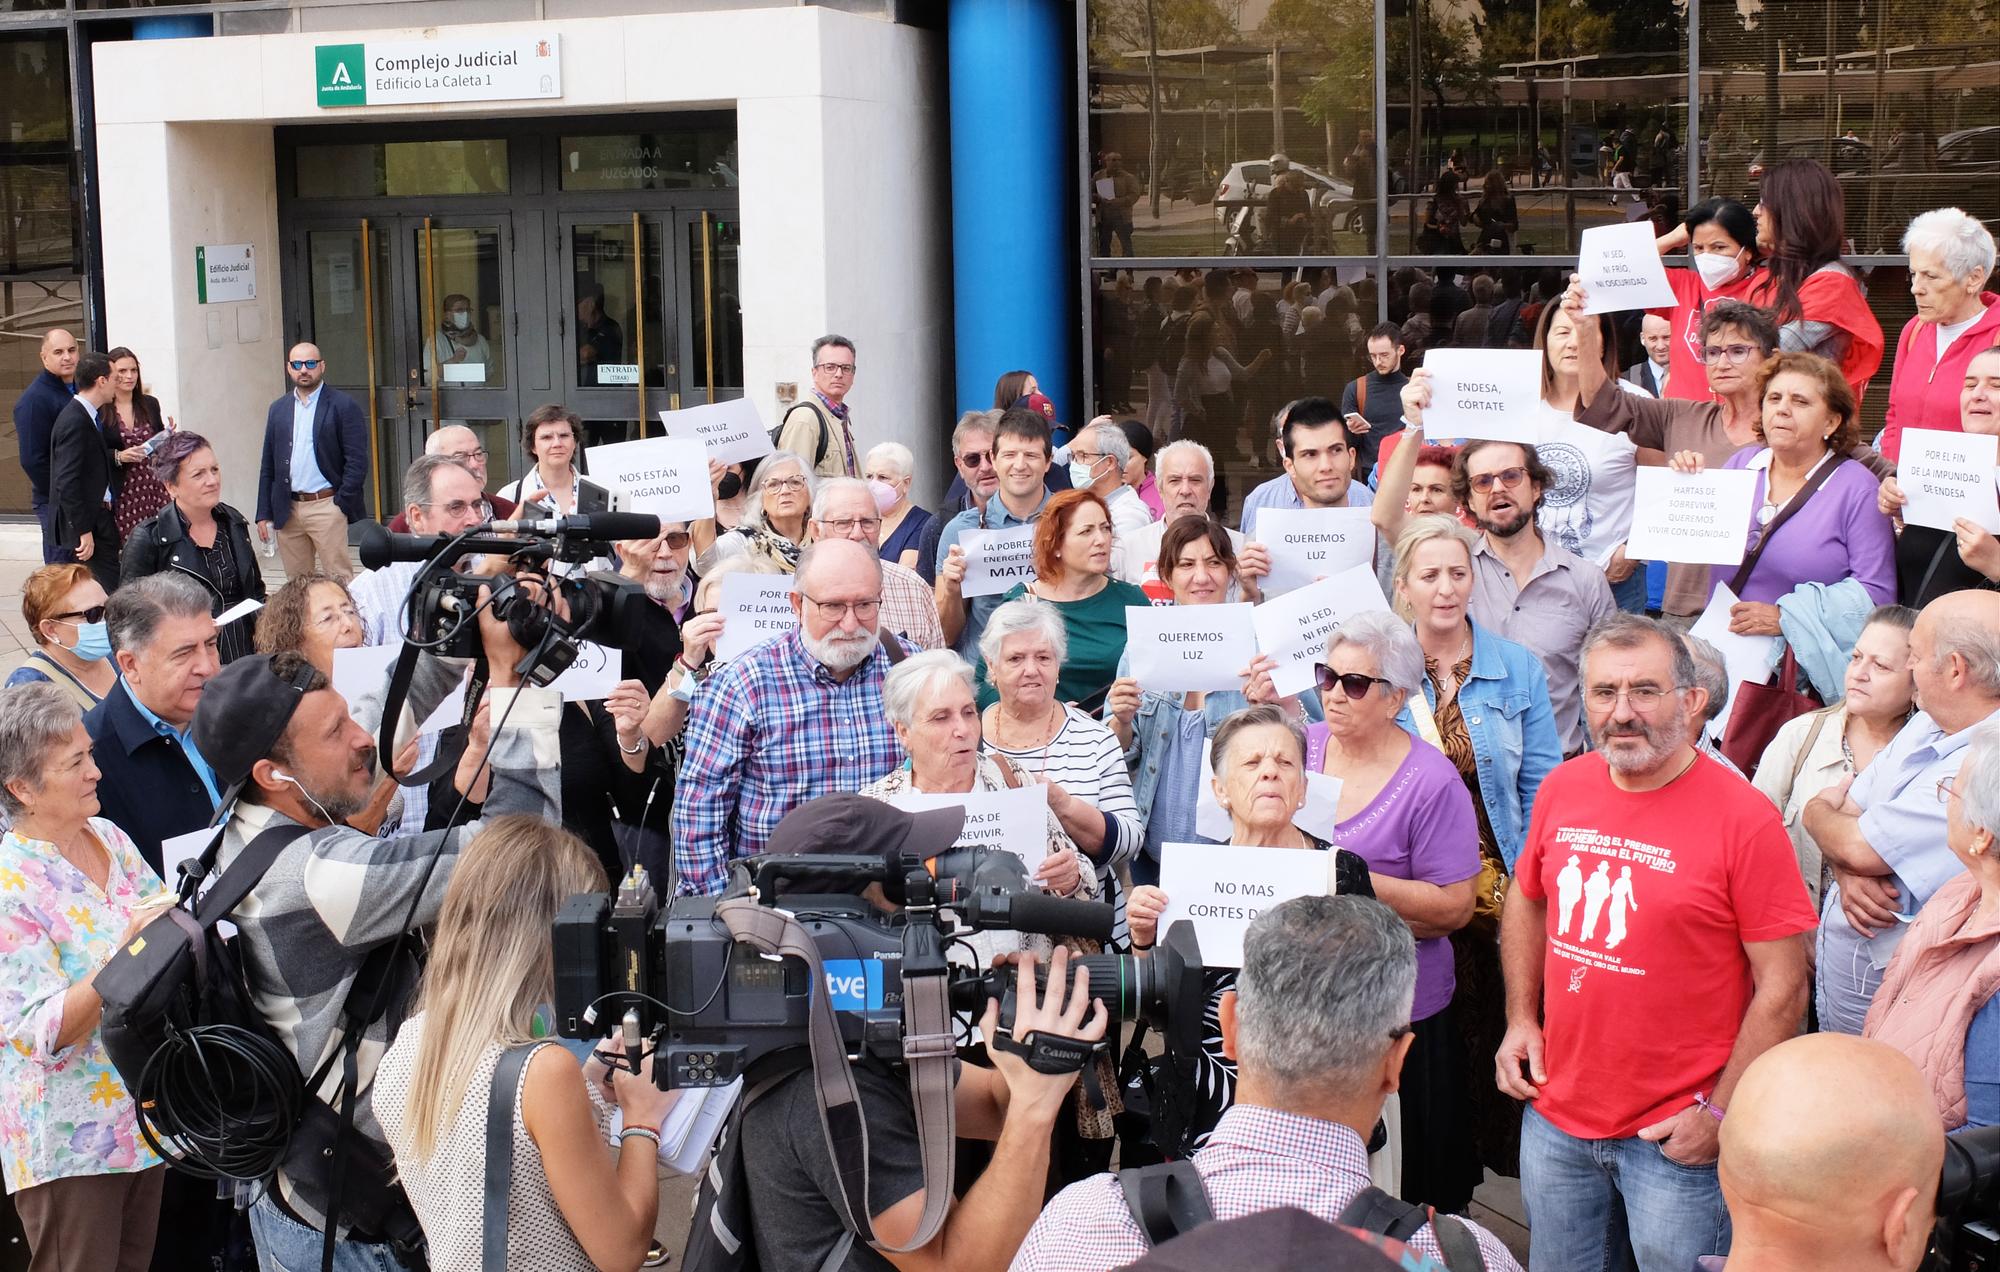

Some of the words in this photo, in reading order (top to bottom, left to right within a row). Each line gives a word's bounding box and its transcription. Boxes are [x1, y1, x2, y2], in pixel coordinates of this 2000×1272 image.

[375, 54, 450, 73] Complejo
[454, 50, 518, 68] Judicial
[376, 76, 422, 91] Edificio
[425, 76, 439, 88] La
[442, 75, 482, 87] Caleta
[485, 75, 492, 85] 1
[653, 146, 662, 159] A
[600, 166, 658, 179] JUZGADOS
[1611, 250, 1626, 259] SED,
[210, 264, 229, 273] Edificio
[230, 263, 250, 272] Judicial
[1605, 277, 1647, 287] OSCURIDAD
[1457, 382, 1501, 395] ENDESA,
[1457, 398, 1505, 412] CÓRTATE
[696, 425, 711, 435] SIN
[713, 423, 728, 432] LUZ
[721, 431, 749, 445] SALUD
[1925, 450, 1941, 461] POR
[1942, 452, 1950, 462] EL
[1953, 453, 1966, 463] FIN
[619, 472, 642, 484] NOS
[644, 467, 678, 481] ESTÁN
[1911, 466, 1921, 476] DE
[1922, 468, 1931, 477] LA
[1932, 469, 1981, 484] IMPUNIDAD
[1673, 486, 1704, 496] HARTAS
[1705, 487, 1717, 496] DE
[1923, 484, 1933, 494] DE
[1934, 486, 1966, 498] ENDESA
[1669, 500, 1718, 511] SOBREVIVIR,
[1668, 513, 1715, 524] QUEREMOS
[1284, 533, 1346, 543] QUEREMOS
[1648, 526, 1669, 535] VIVIR
[1671, 528, 1688, 536] CON
[1690, 529, 1730, 539] DIGNIDAD
[983, 543, 995, 552] LA
[997, 540, 1032, 551] POBREZ
[1307, 551, 1326, 560] LUZ
[990, 564, 1036, 578] MATA
[759, 590, 781, 599] POR
[739, 604, 753, 613] DE
[755, 605, 767, 613] LA
[1298, 615, 1311, 627] NI
[1312, 607, 1336, 622] SED,
[754, 619, 767, 629] DE
[1158, 632, 1224, 643] QUEREMOS
[1302, 631, 1315, 642] NI
[1183, 651, 1204, 660] LUZ
[1292, 649, 1306, 661] NI
[987, 812, 1001, 822] DE
[1555, 832, 1612, 847] LUCHEMOS
[1611, 836, 1623, 847] EL
[1624, 839, 1672, 858] PRESENTE
[1570, 843, 1589, 853] PARA
[1590, 845, 1618, 858] GANAR
[1618, 849, 1632, 860] EL
[1632, 851, 1677, 870] FUTURO
[1214, 881, 1237, 894] NO
[1241, 883, 1275, 898] MAS
[1188, 904, 1244, 919] CORTES
[1571, 953, 1586, 964] TODO
[1585, 958, 1593, 966] EL
[1593, 960, 1607, 969] ORO
[1607, 963, 1620, 972] DEL
[1620, 966, 1646, 976] MUNDO
[1604, 954, 1622, 964] VALE
[826, 972, 865, 999] tve
[1039, 1045, 1083, 1060] Canon
